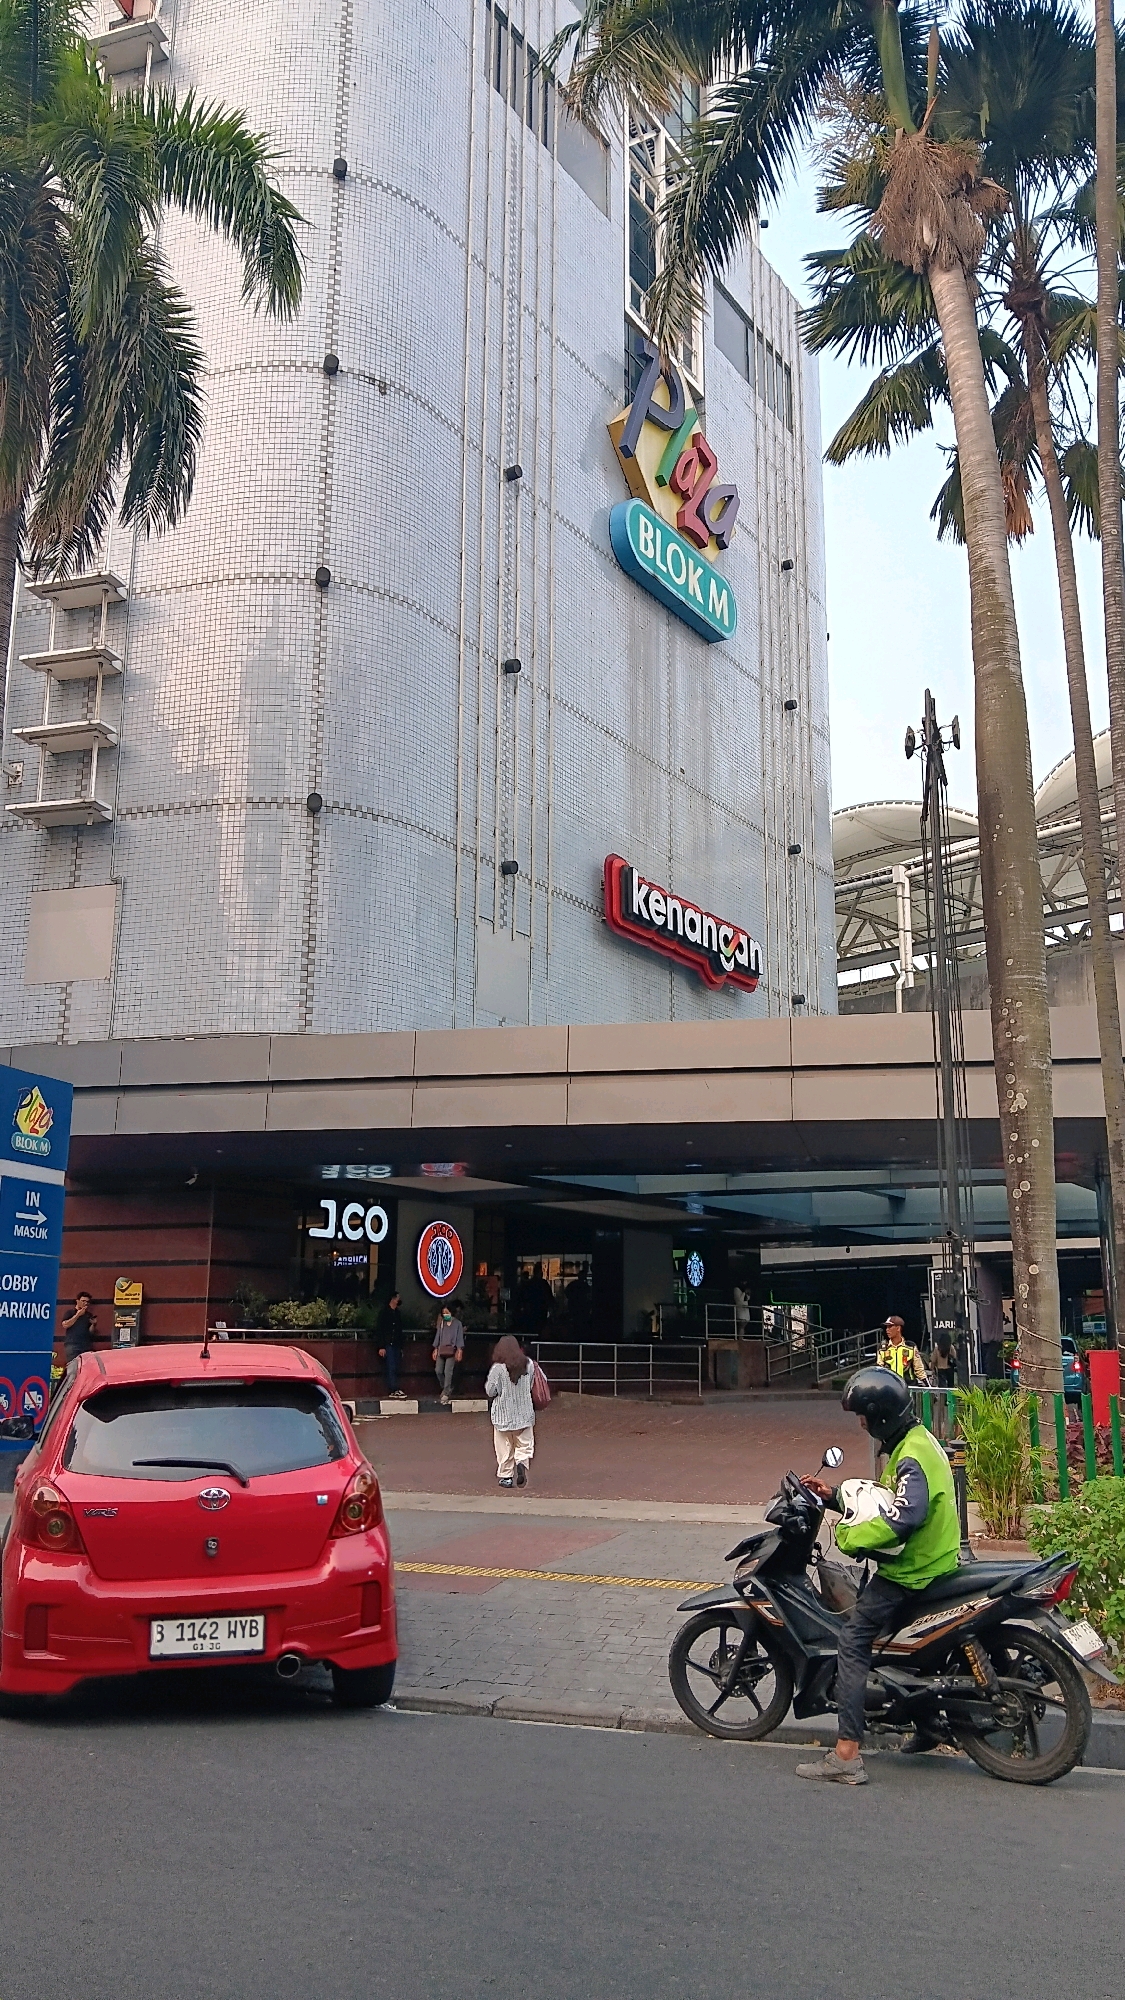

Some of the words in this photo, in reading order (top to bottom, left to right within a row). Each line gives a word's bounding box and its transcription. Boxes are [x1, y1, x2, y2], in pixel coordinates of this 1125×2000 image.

[638, 513, 704, 602] BLOK
[708, 577, 730, 627] M
[632, 866, 764, 975] kenangan
[15, 1135, 39, 1151] BLOK
[39, 1141, 48, 1153] M
[25, 1190, 41, 1208] IN
[308, 1199, 389, 1243] J.CO
[13, 1224, 48, 1240] MASUK
[934, 1320, 956, 1329] JARI
[156, 1623, 165, 1643] B
[175, 1621, 220, 1642] 1142
[227, 1619, 260, 1639] WYB
